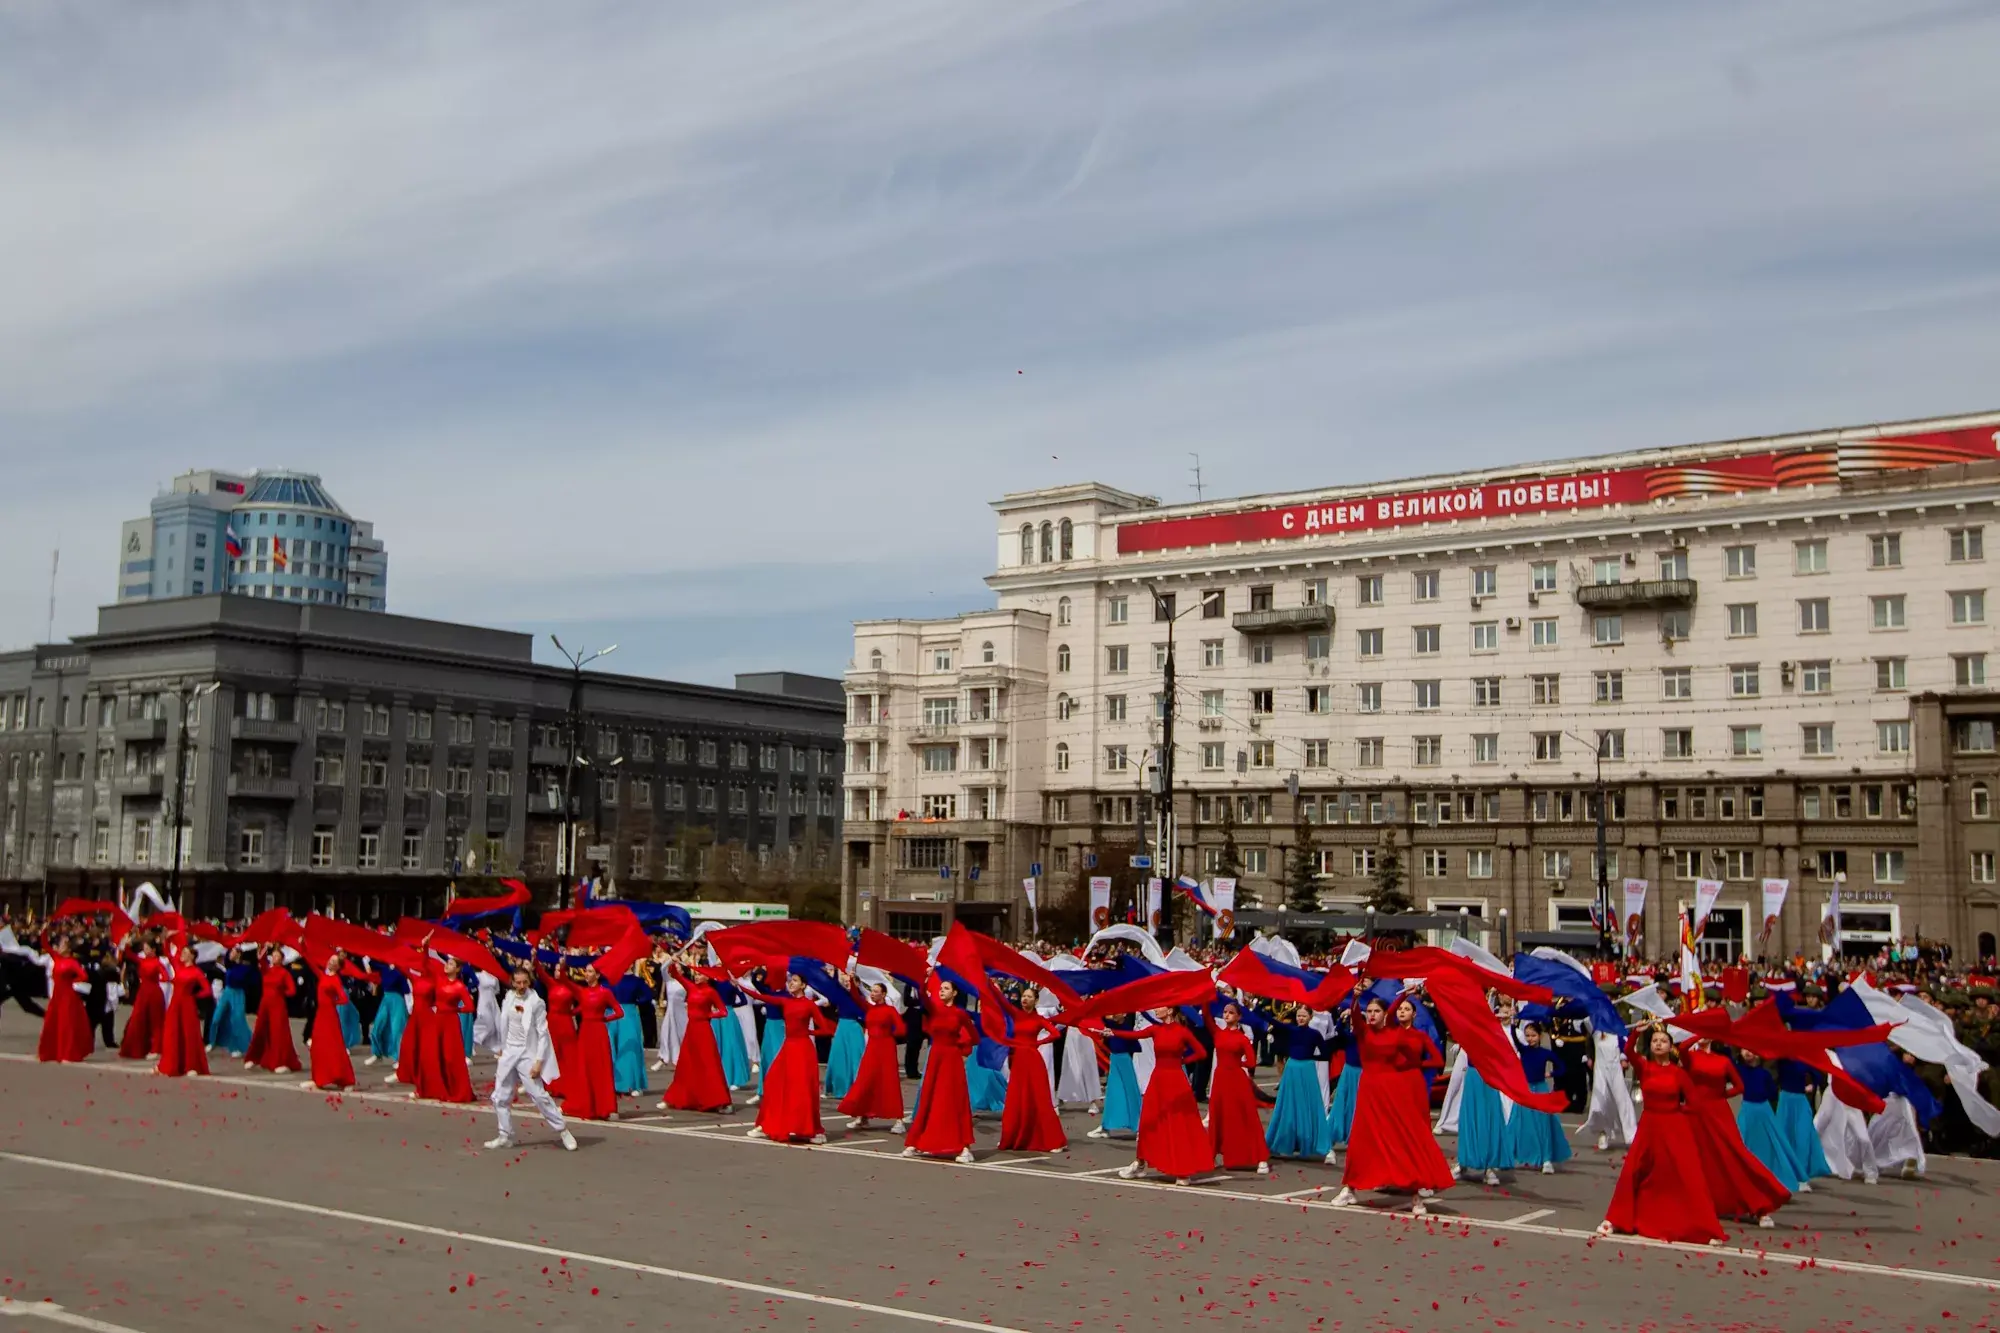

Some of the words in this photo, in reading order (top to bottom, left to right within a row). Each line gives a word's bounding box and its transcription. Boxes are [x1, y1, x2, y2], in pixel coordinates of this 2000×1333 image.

[1282, 512, 1294, 530] С
[1304, 504, 1365, 531] ДНЕМ
[1377, 487, 1483, 520] ВЕЛИКОЙ
[1497, 477, 1610, 508] ПОБЕДЫ!
